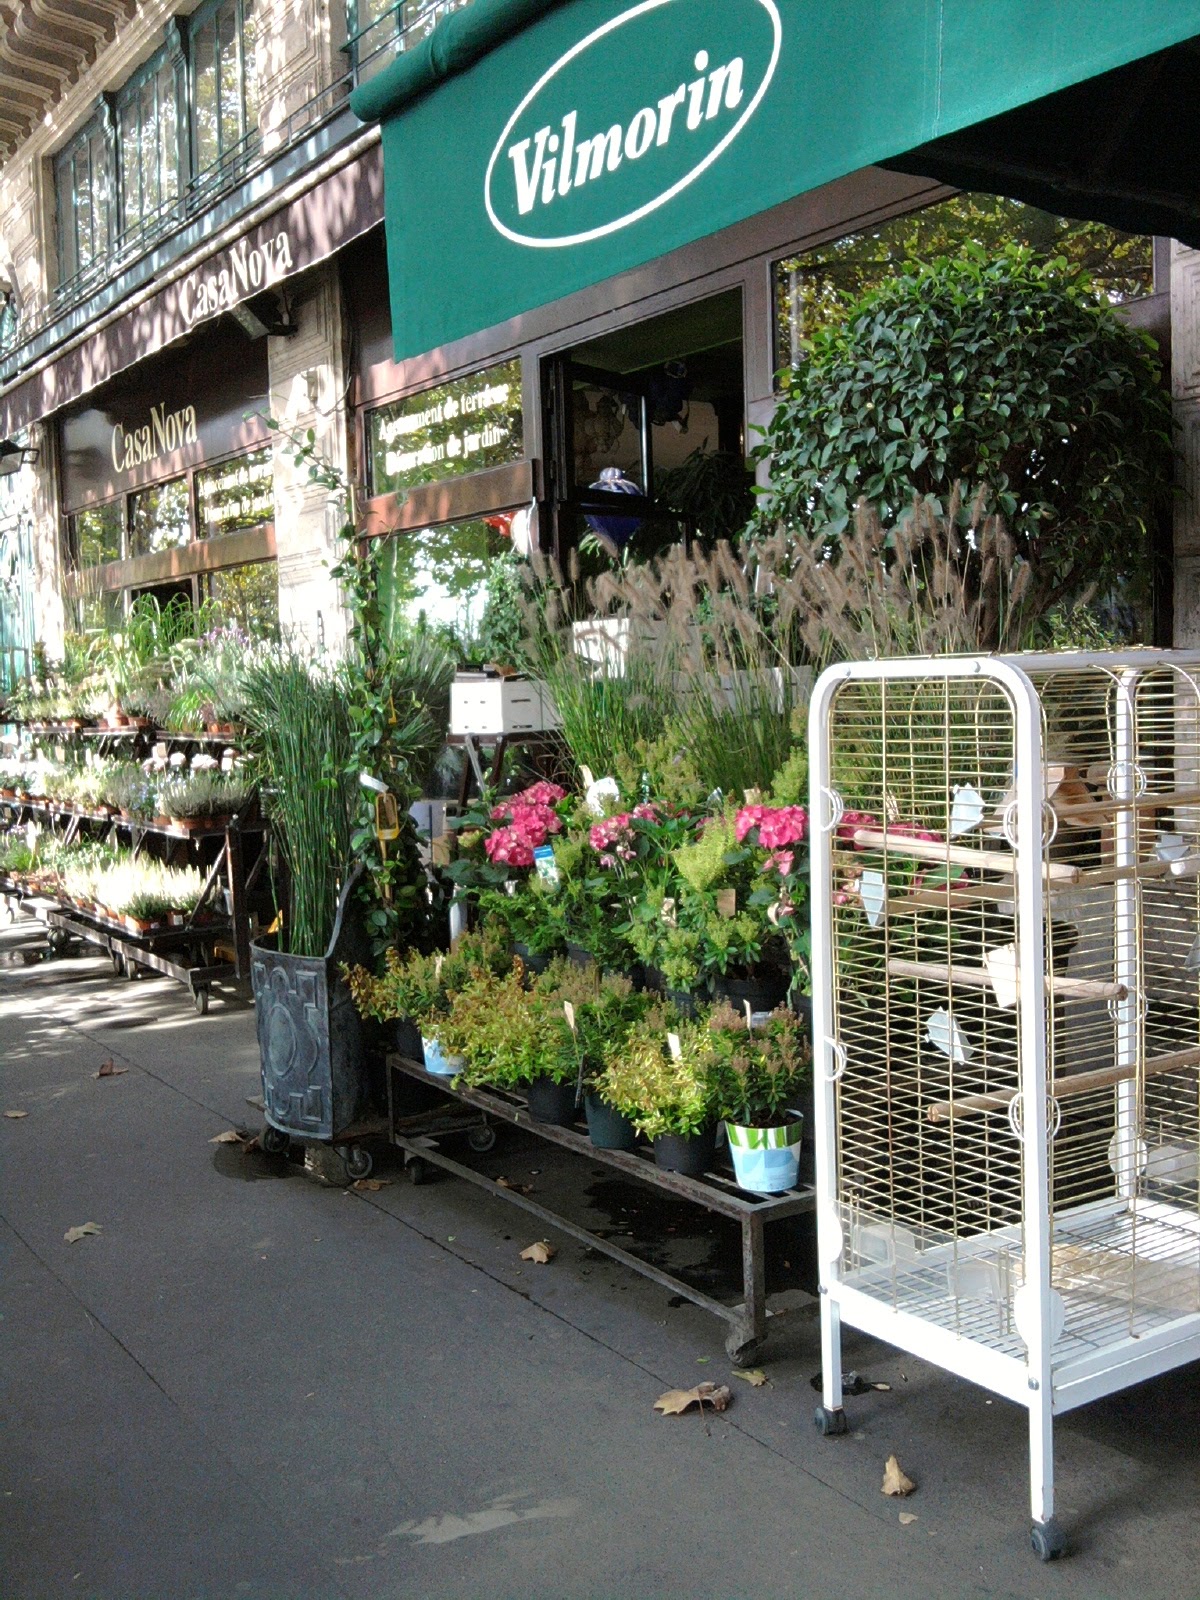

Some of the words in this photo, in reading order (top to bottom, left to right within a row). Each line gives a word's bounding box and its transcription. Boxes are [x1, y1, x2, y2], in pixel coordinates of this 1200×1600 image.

[508, 50, 744, 215] Vilmorin
[178, 232, 293, 324] CasaNova
[111, 401, 197, 473] CasaNova
